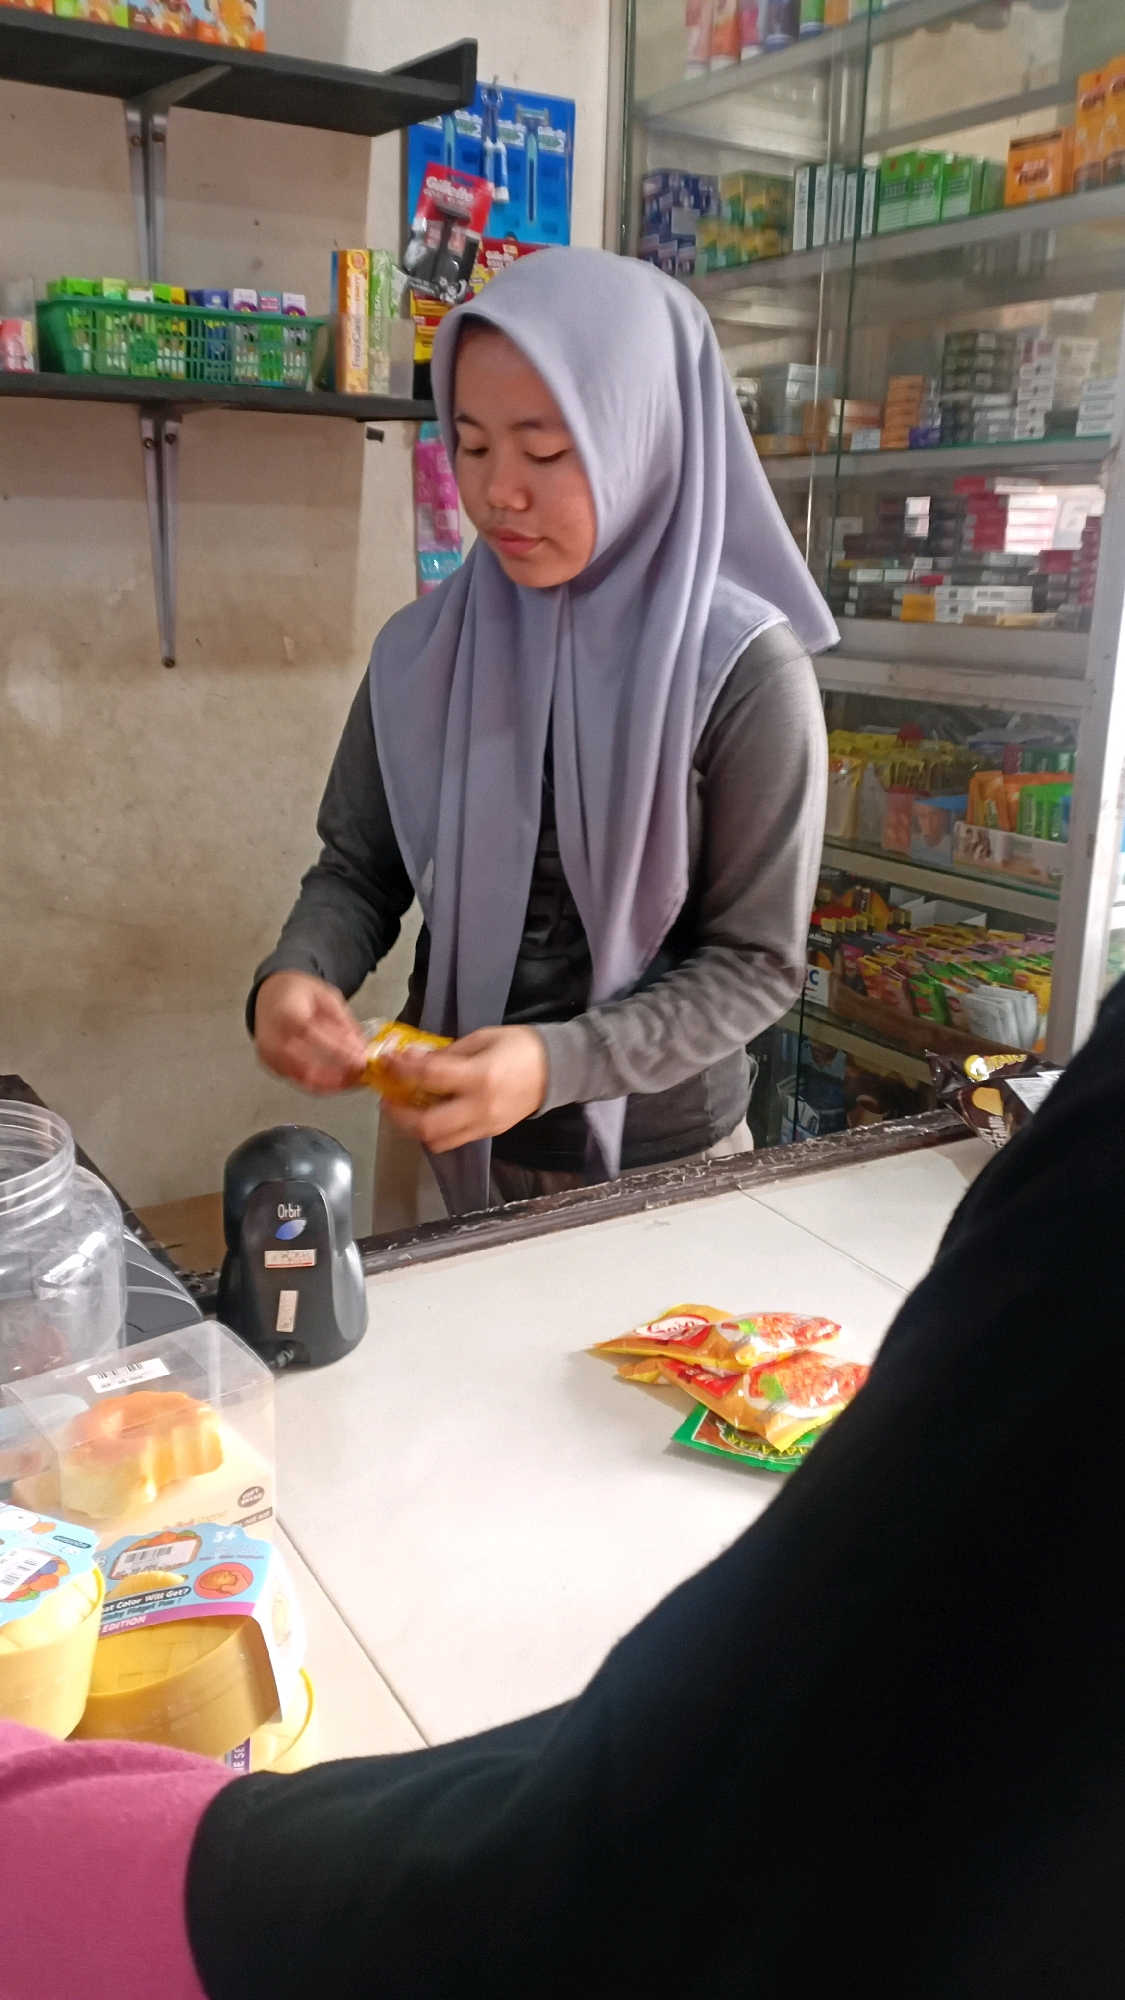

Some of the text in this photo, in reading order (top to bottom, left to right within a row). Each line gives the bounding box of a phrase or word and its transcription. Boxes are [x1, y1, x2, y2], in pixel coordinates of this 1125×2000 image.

[277, 1203, 302, 1218] Orbit
[116, 1598, 143, 1609] Color
[144, 1592, 165, 1602] Will
[102, 1615, 148, 1633] EDITION
